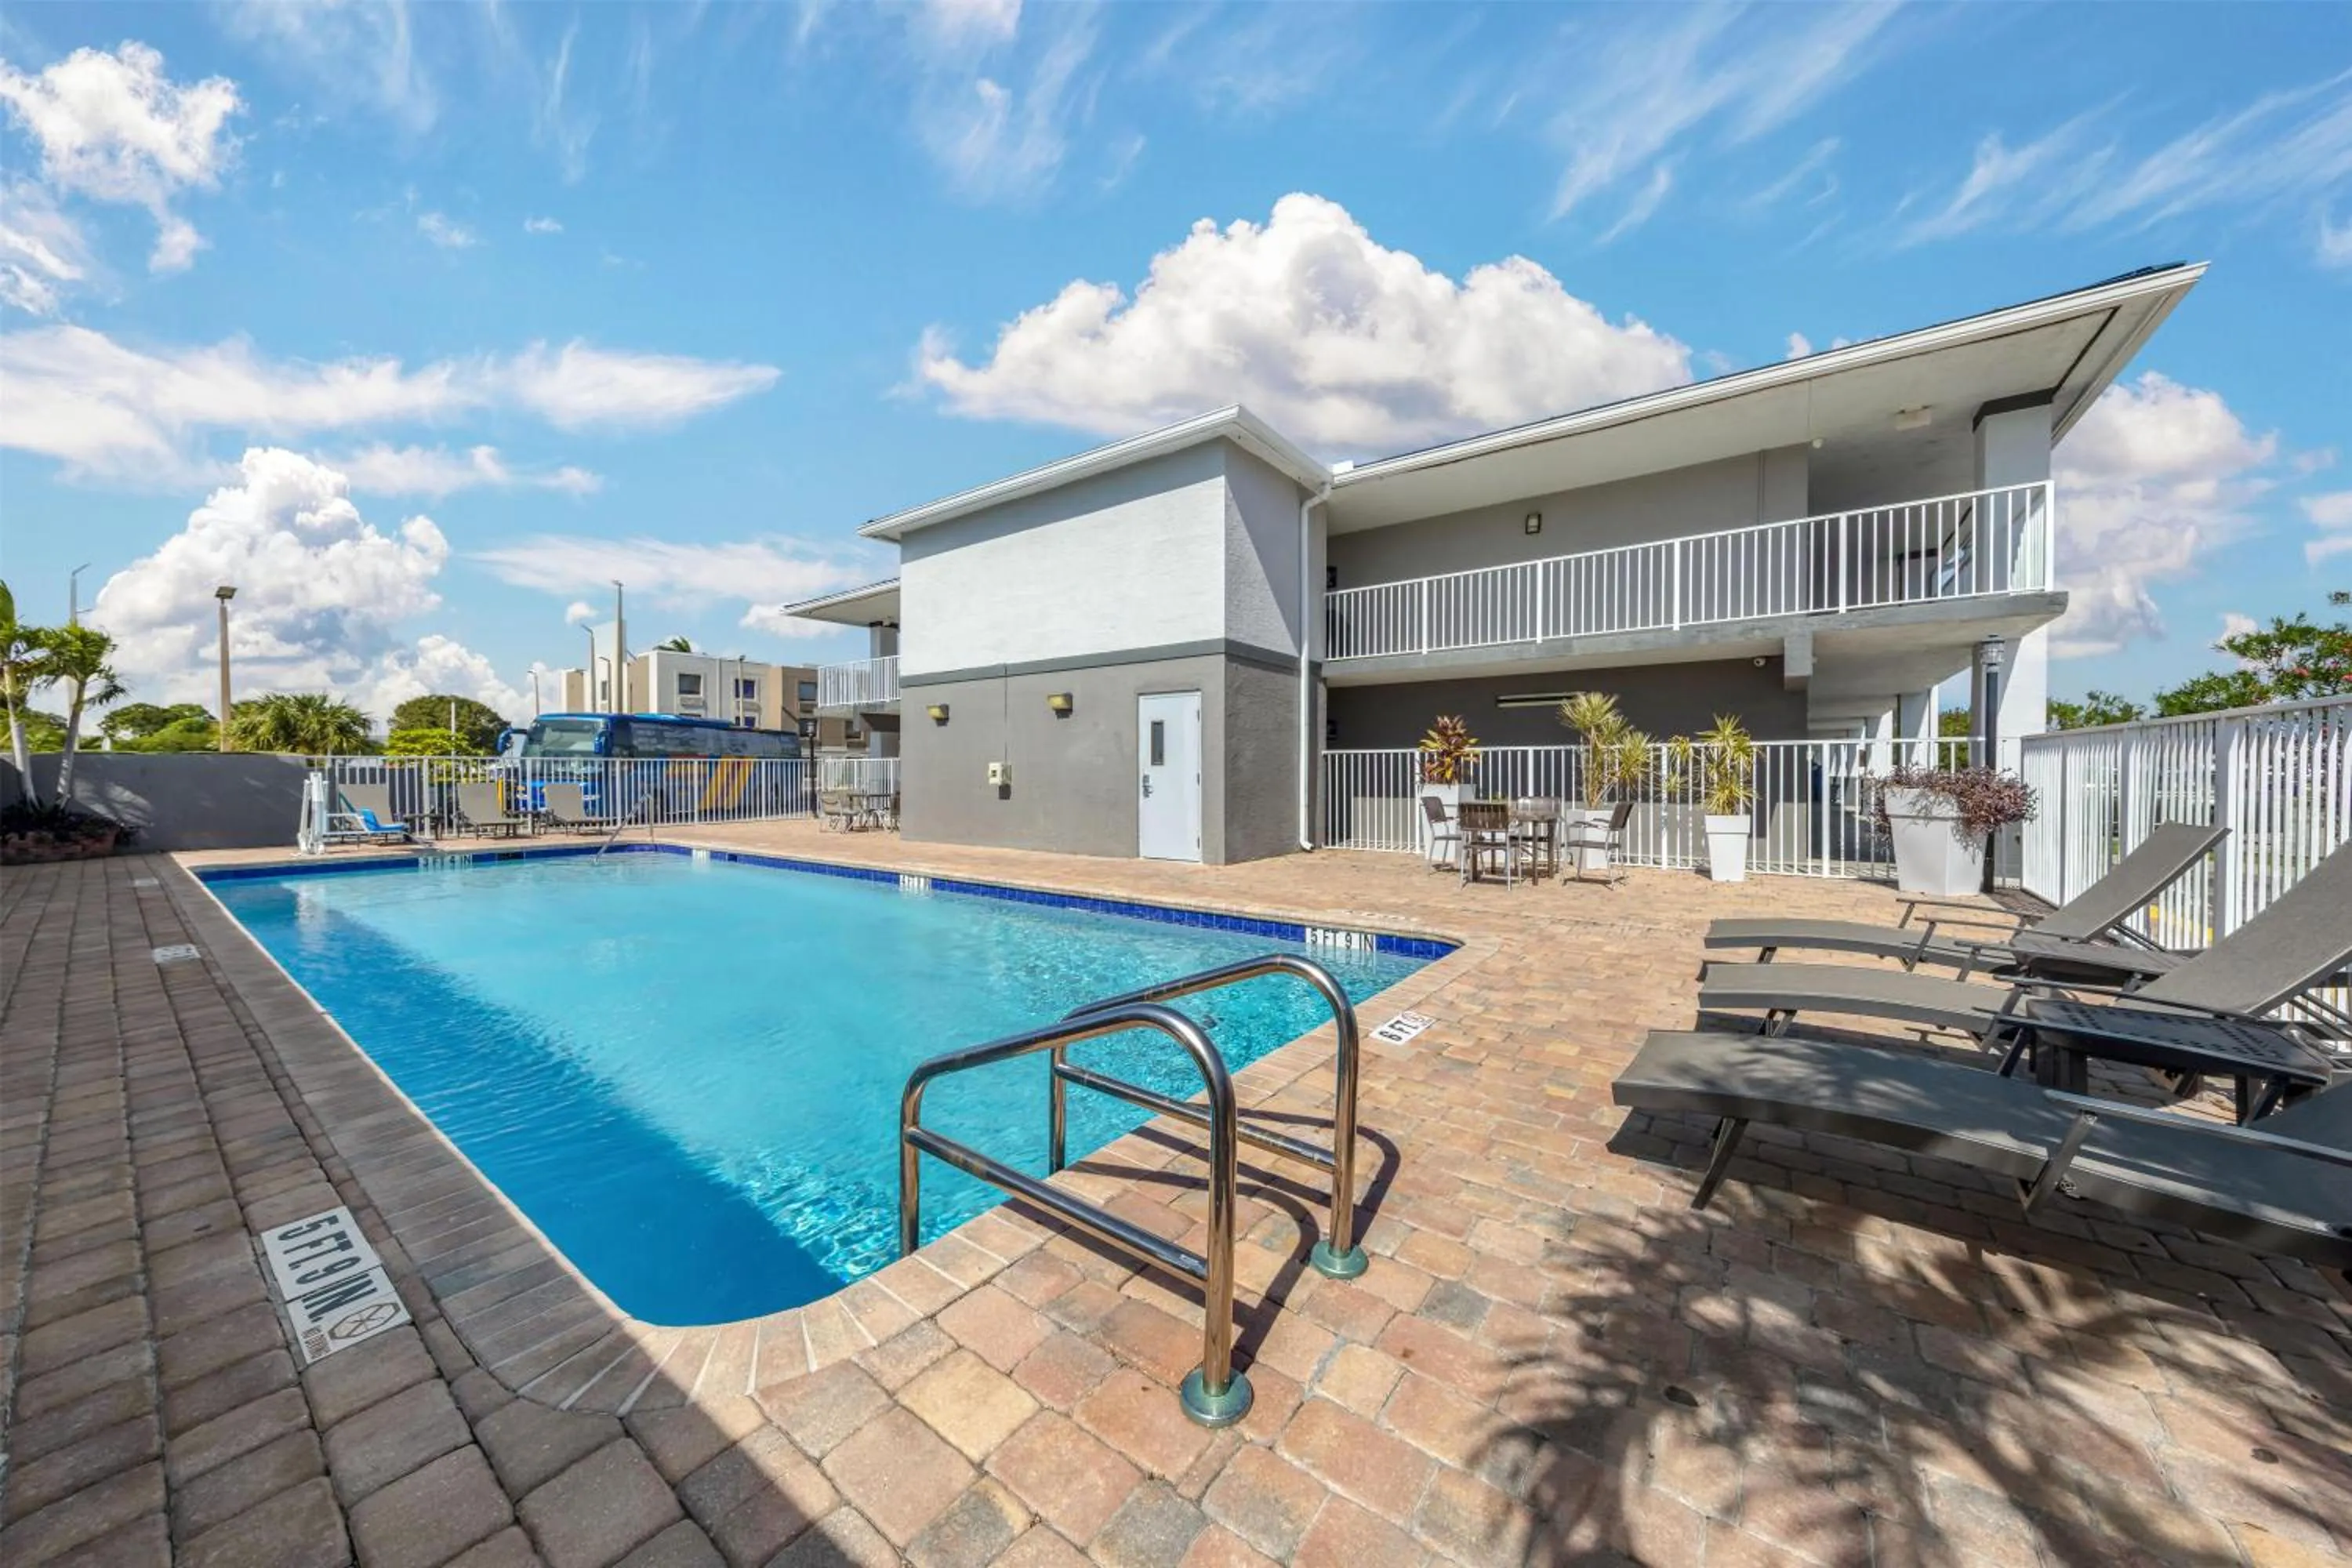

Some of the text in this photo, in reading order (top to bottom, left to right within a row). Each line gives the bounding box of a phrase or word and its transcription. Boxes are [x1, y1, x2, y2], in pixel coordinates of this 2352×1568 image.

[1311, 926, 1374, 952] 5 FT 9 IN
[1378, 1031, 1403, 1042] 6
[278, 1215, 339, 1241] 5
[296, 1256, 362, 1285] 9
